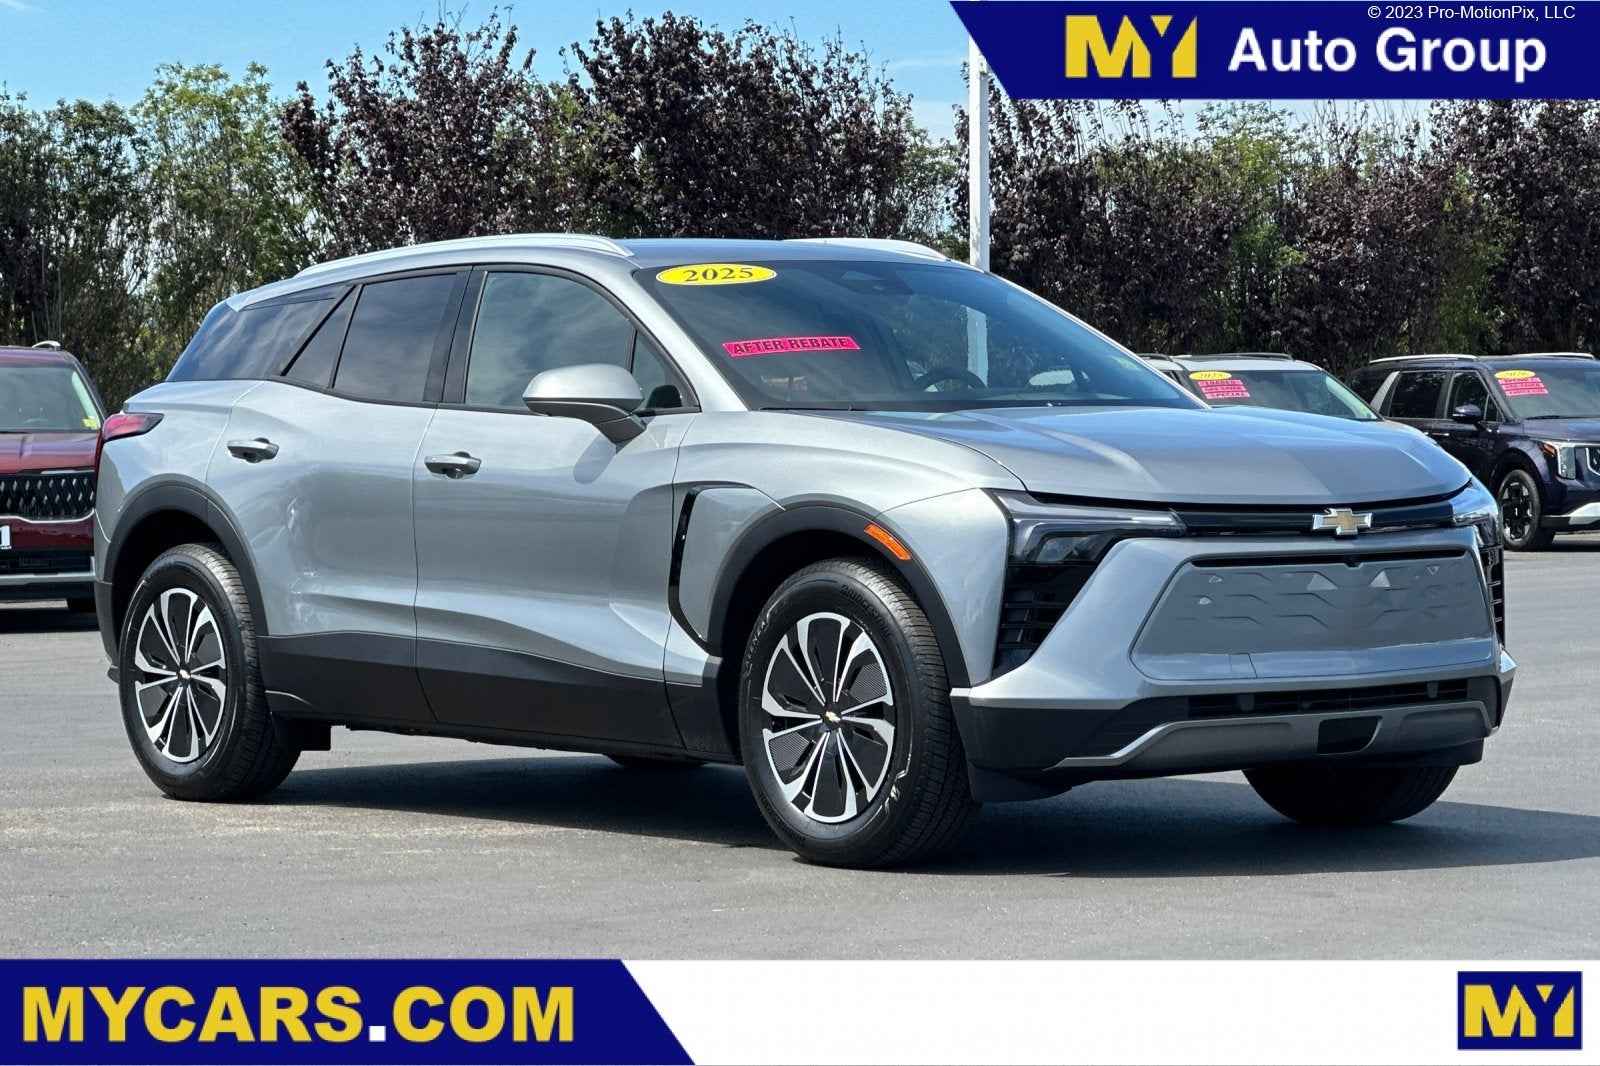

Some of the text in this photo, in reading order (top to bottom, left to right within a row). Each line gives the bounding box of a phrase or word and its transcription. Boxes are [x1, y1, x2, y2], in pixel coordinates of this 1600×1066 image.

[683, 267, 754, 282] 2025
[733, 337, 849, 354] AFTER REBATE
